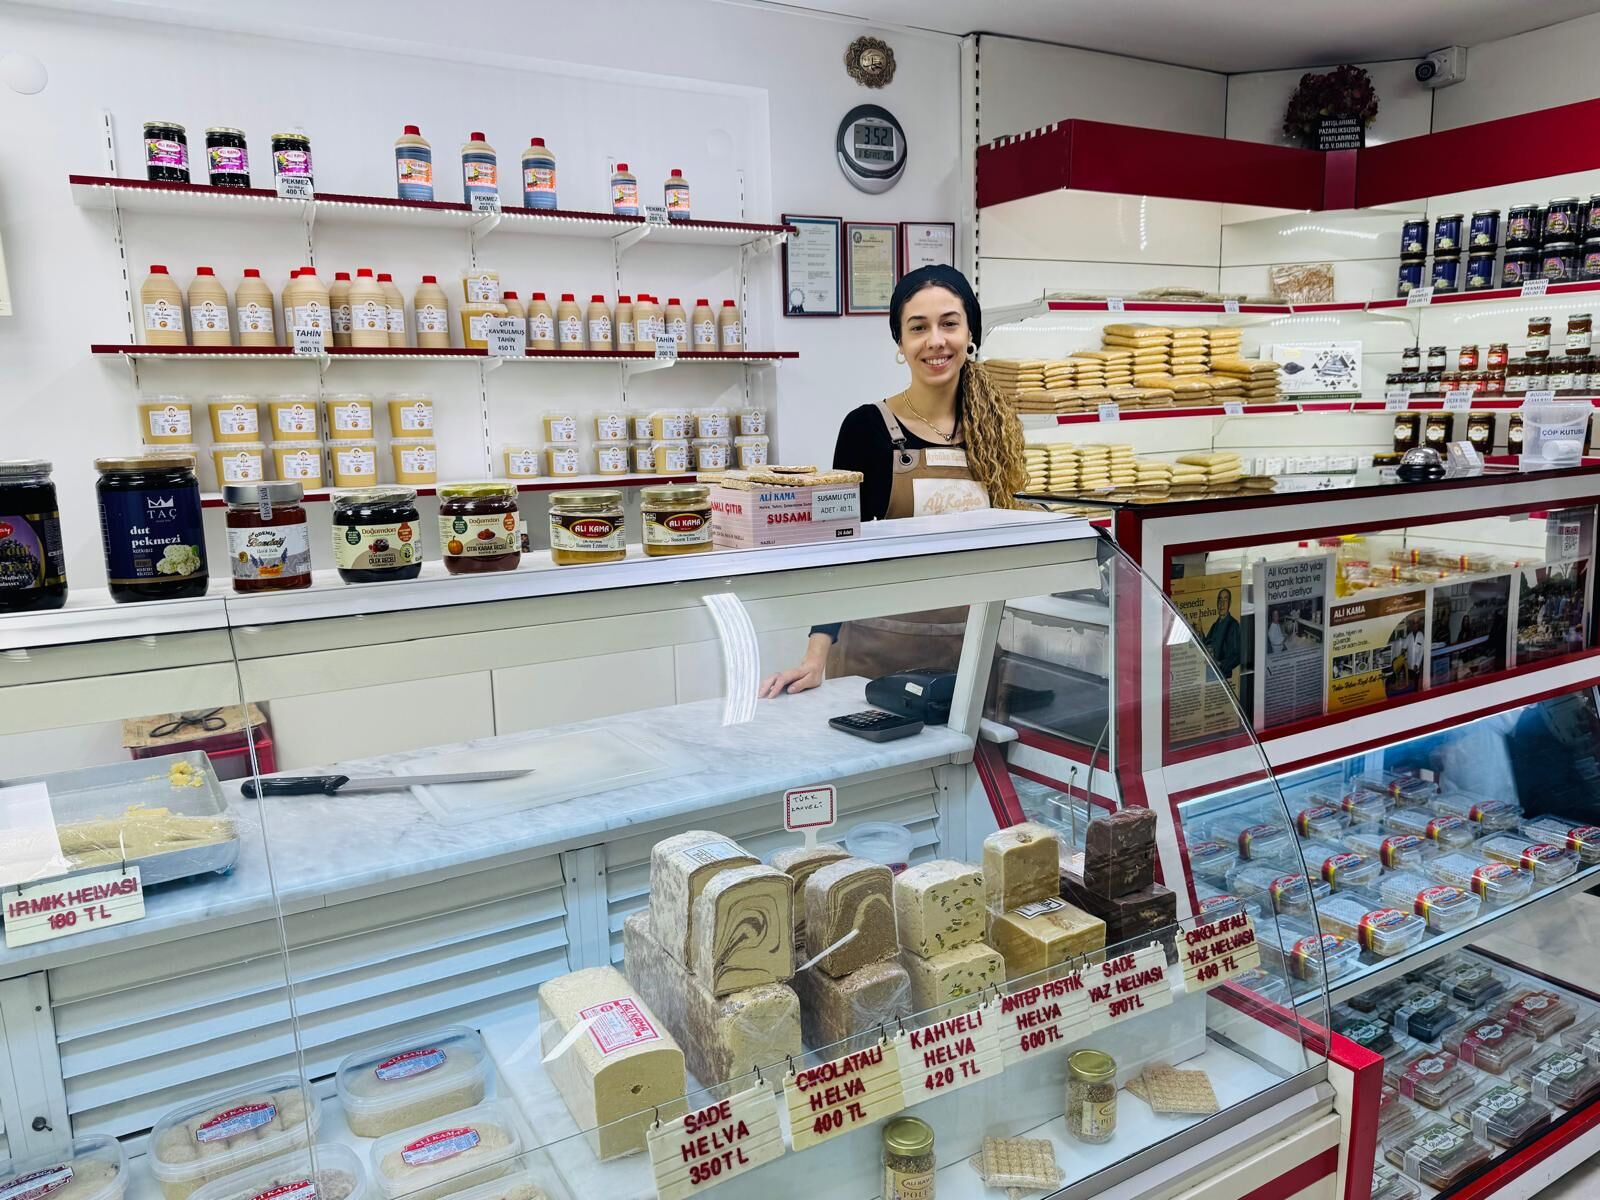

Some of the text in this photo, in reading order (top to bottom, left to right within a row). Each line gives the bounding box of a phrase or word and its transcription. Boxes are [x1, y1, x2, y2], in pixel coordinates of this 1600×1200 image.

[864, 127, 888, 146] 3:52
[281, 178, 309, 186] PEKMEZ
[296, 329, 321, 337] TAHİN
[1542, 428, 1558, 436] ÇÖP
[760, 490, 796, 502] ALİ KAMA
[146, 508, 177, 520] TAÇ
[725, 503, 743, 516] ÇITIR
[588, 525, 610, 533] KAMA
[682, 518, 700, 526] KAMA
[130, 526, 150, 535] dut
[131, 534, 182, 549] pekmezi
[1268, 568, 1276, 576] Ali
[1278, 566, 1298, 576] Kama
[1300, 562, 1308, 572] 50
[1268, 577, 1294, 590] organik
[1313, 574, 1320, 582] ve
[1268, 590, 1288, 600] helva
[1180, 598, 1205, 610] senedir
[1346, 605, 1366, 616] KAMA
[1200, 608, 1217, 618] helva
[792, 794, 818, 803] TÜRK
[9, 877, 138, 918] IRMIK HELVASI
[48, 904, 112, 930] 180 TL
[1187, 928, 1255, 965] YAZ HELVASI
[1102, 953, 1137, 978] SADE
[1197, 954, 1239, 982] 400 TL
[1088, 965, 1164, 1003] YAZ HELVASI
[1001, 973, 1084, 1015] ANTEP FISTIK
[1016, 1002, 1062, 1031] HELVA
[910, 1010, 983, 1050] KAHVELI
[923, 1036, 976, 1068] HELVA
[924, 1058, 981, 1090] 420 TL
[810, 1077, 866, 1112] HELVA
[684, 1100, 732, 1134] SADE
[814, 1102, 867, 1134] 400 TL
[432, 1130, 464, 1141] KAMA
[681, 1120, 750, 1162] HELVA
